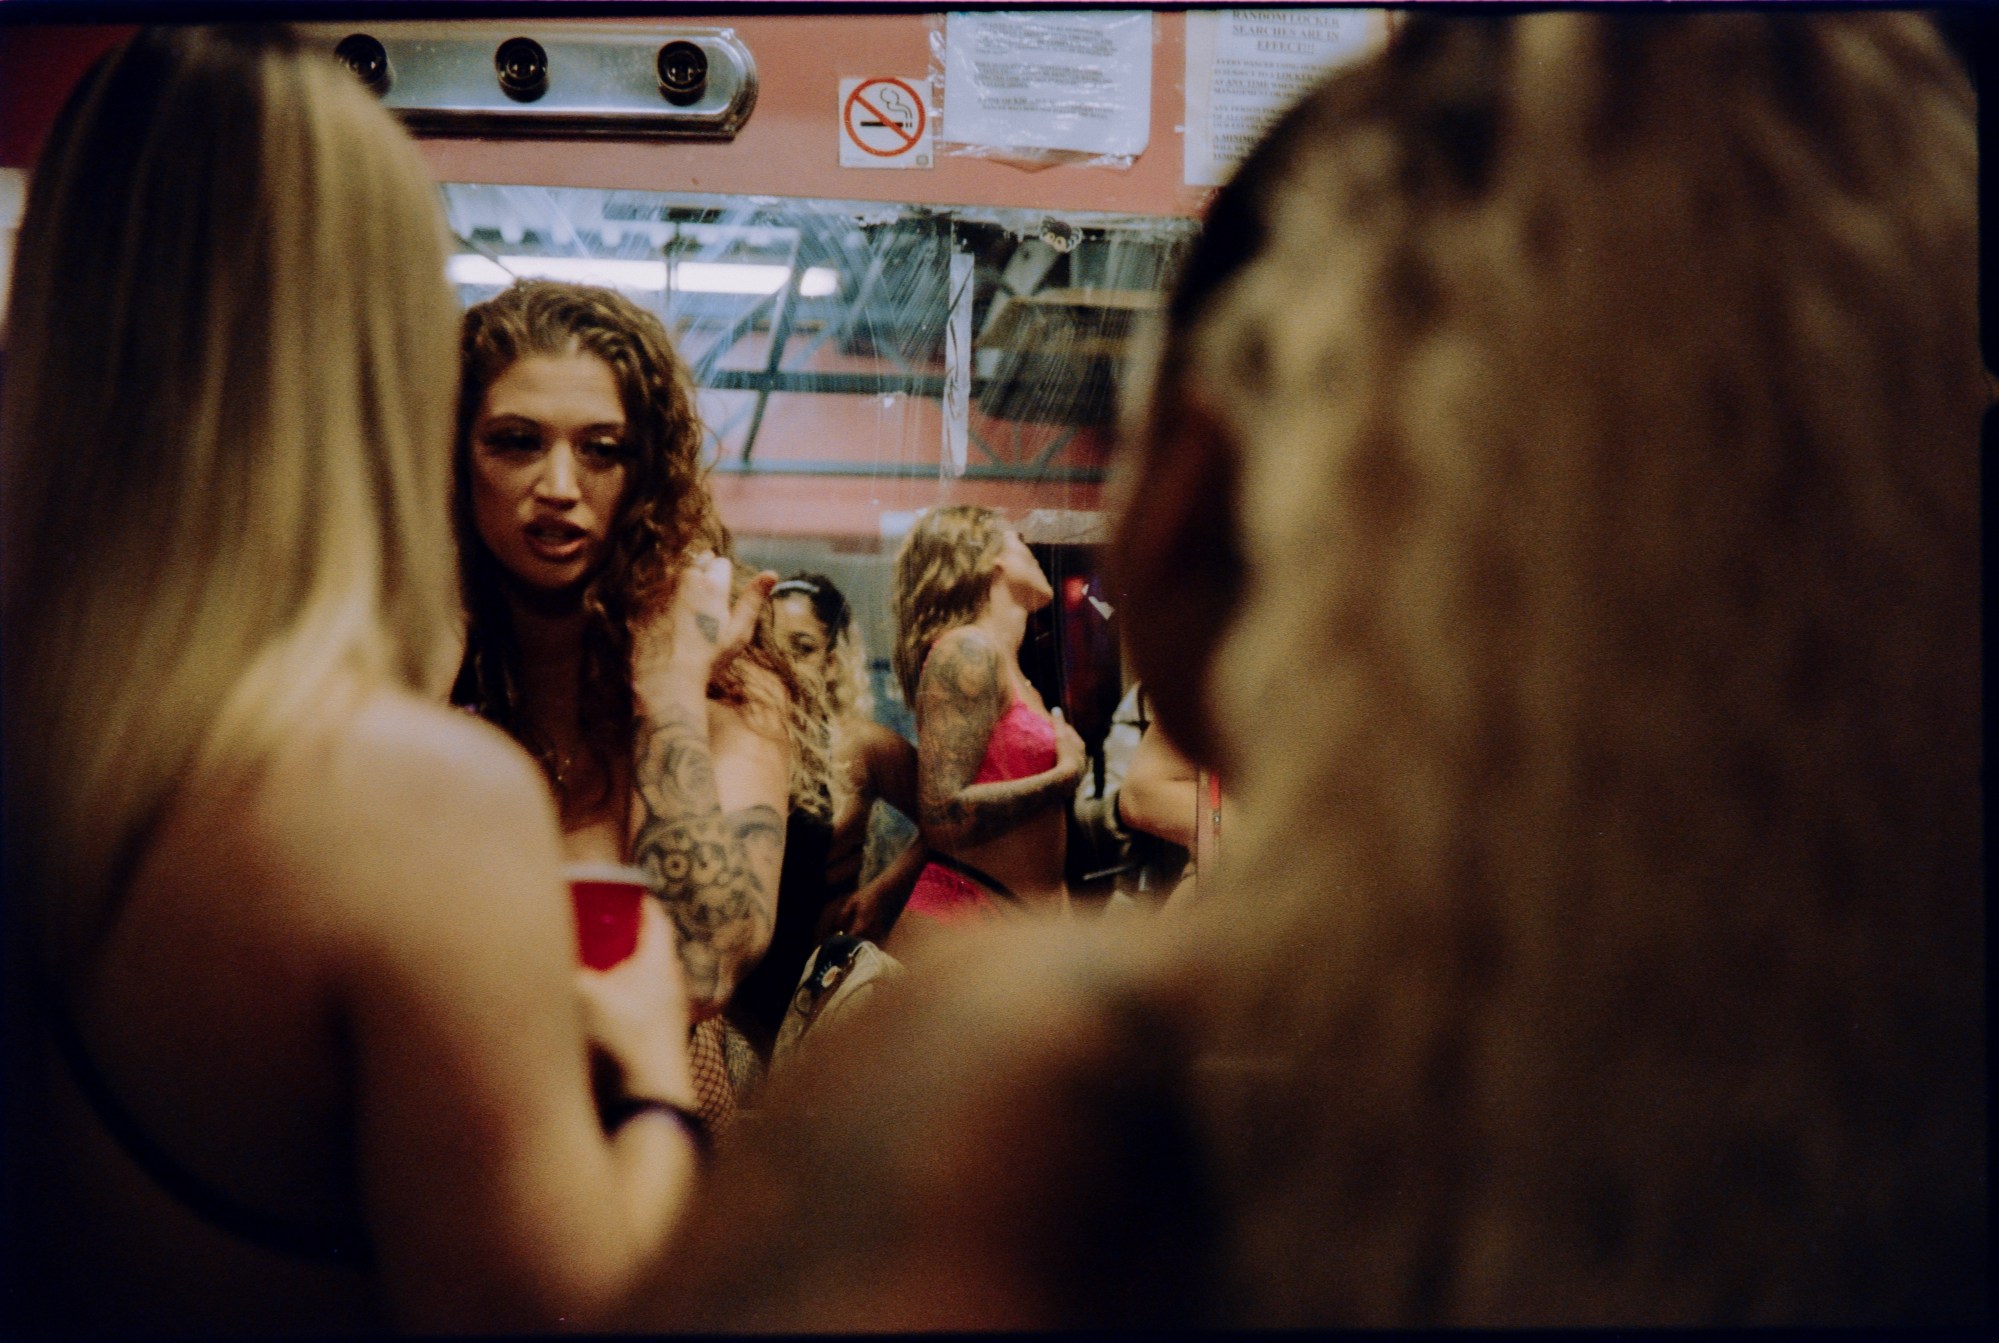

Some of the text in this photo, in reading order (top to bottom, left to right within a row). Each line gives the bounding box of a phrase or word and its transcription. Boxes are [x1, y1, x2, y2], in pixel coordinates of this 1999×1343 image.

[1232, 10, 1339, 27] RANDOM LOCKER
[1232, 25, 1339, 41] SEARCHES ARE IN
